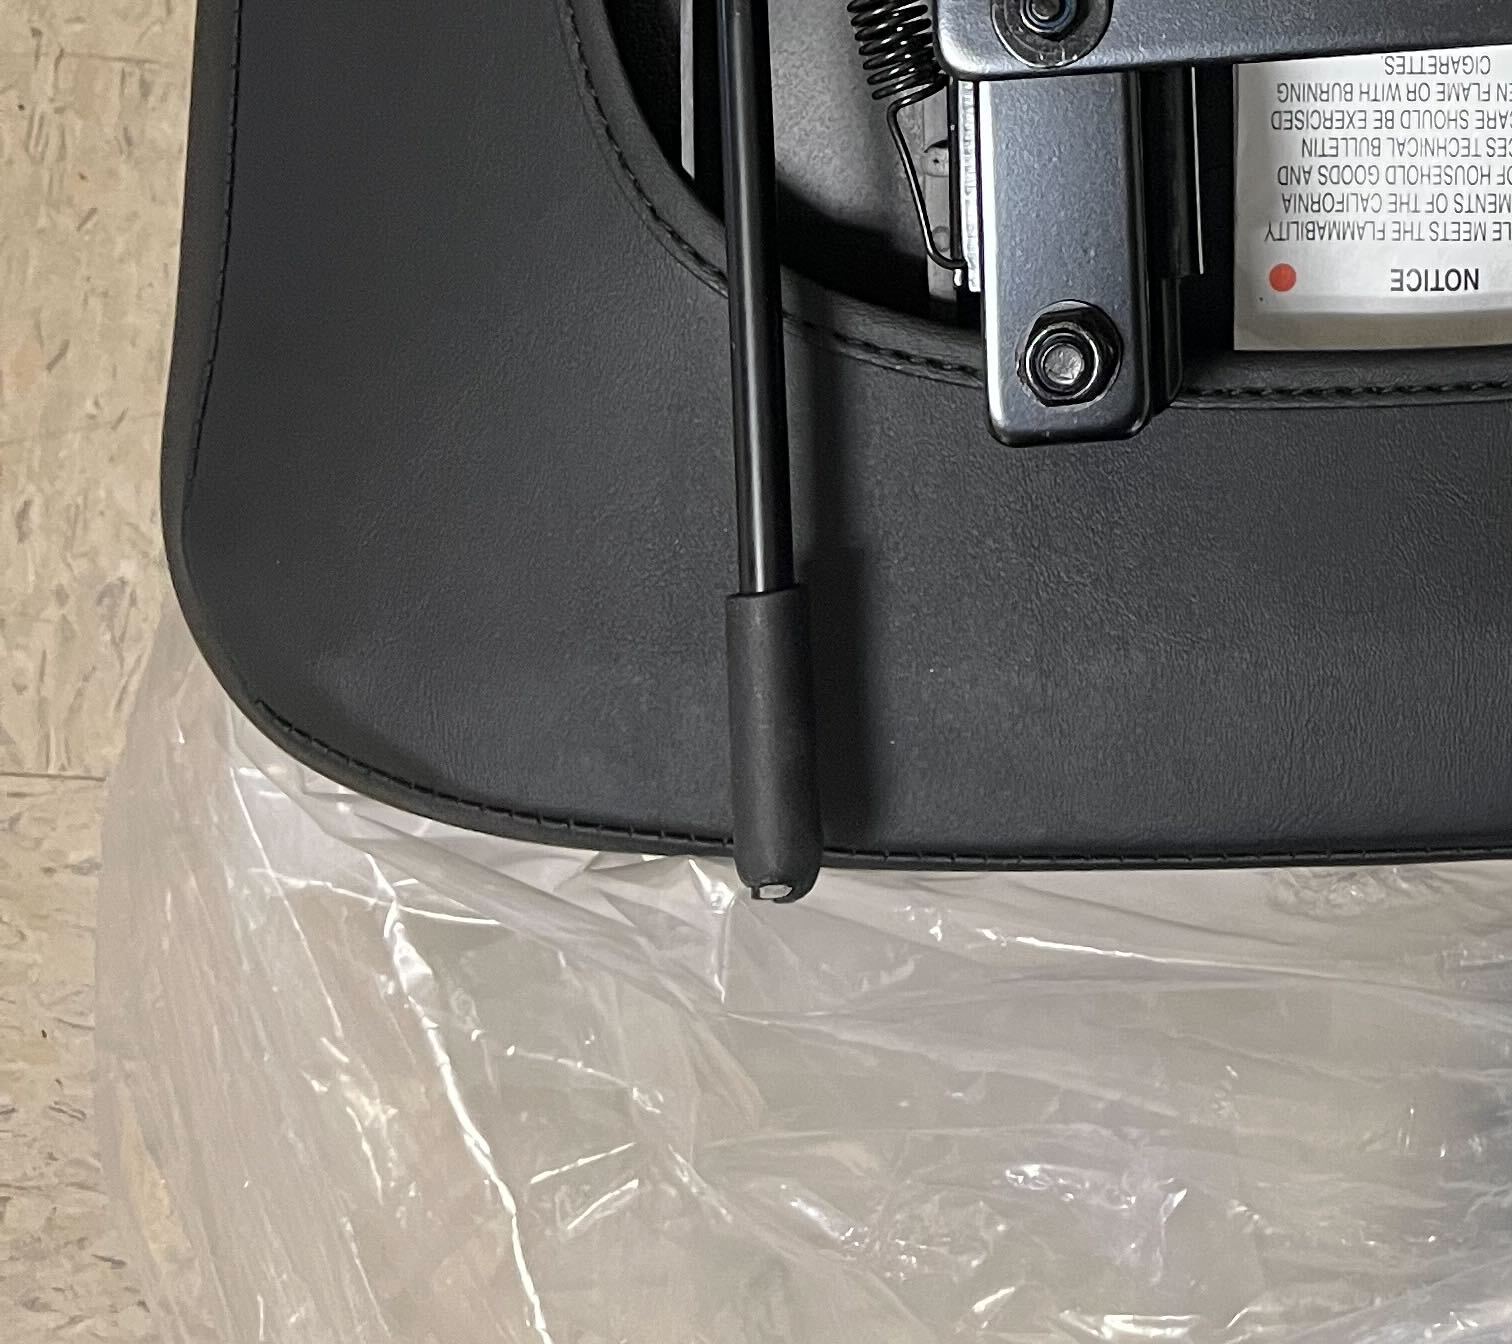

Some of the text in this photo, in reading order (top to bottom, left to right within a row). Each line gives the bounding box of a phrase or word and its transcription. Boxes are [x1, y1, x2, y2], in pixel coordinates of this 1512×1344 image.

[1381, 55, 1491, 75] CIGARETTES.
[1277, 82, 1353, 103] BURNING
[1360, 82, 1401, 103] WITH
[1406, 82, 1431, 103] OR
[1436, 82, 1491, 103] FLAME
[1271, 109, 1367, 131] EXERCISED
[1373, 109, 1395, 130] BE
[1400, 109, 1469, 130] SHOULD
[1302, 137, 1381, 158] BULLETIN
[1387, 137, 1482, 158] TECHNICAL
[1277, 165, 1313, 186] AND
[1318, 165, 1380, 186] GOODS
[1385, 165, 1491, 186] HOUSEHOLD
[1281, 192, 1383, 214] CALIFORNIA
[1388, 192, 1421, 214] THE
[1424, 192, 1448, 214] OF
[1264, 221, 1386, 243] FLAMMABILITY
[1392, 221, 1425, 242] THE
[1429, 221, 1487, 242] MEETS
[1390, 267, 1480, 292] NOTICE
